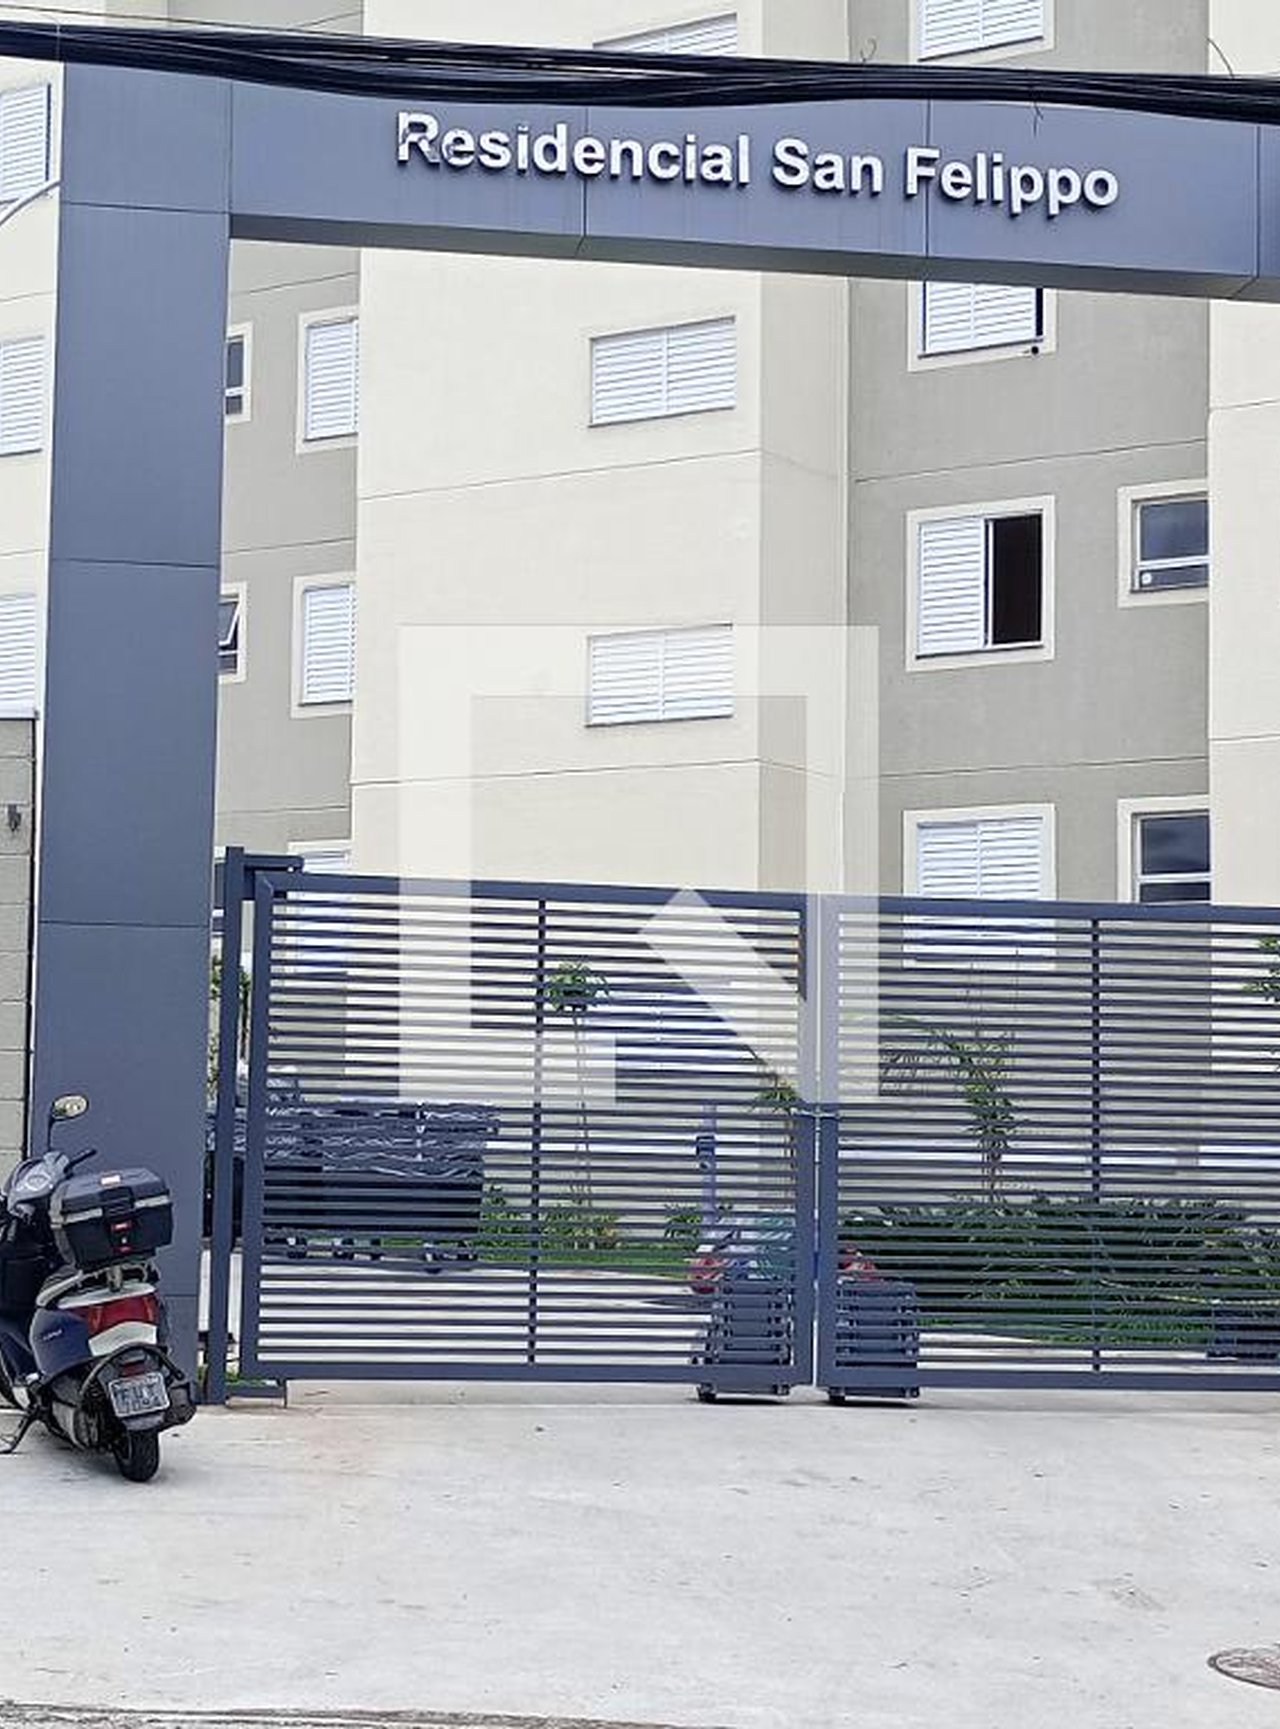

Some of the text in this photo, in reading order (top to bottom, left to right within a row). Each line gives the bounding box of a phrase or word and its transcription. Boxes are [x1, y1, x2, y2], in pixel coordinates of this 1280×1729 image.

[398, 111, 1119, 216] Residencial San Felippo
